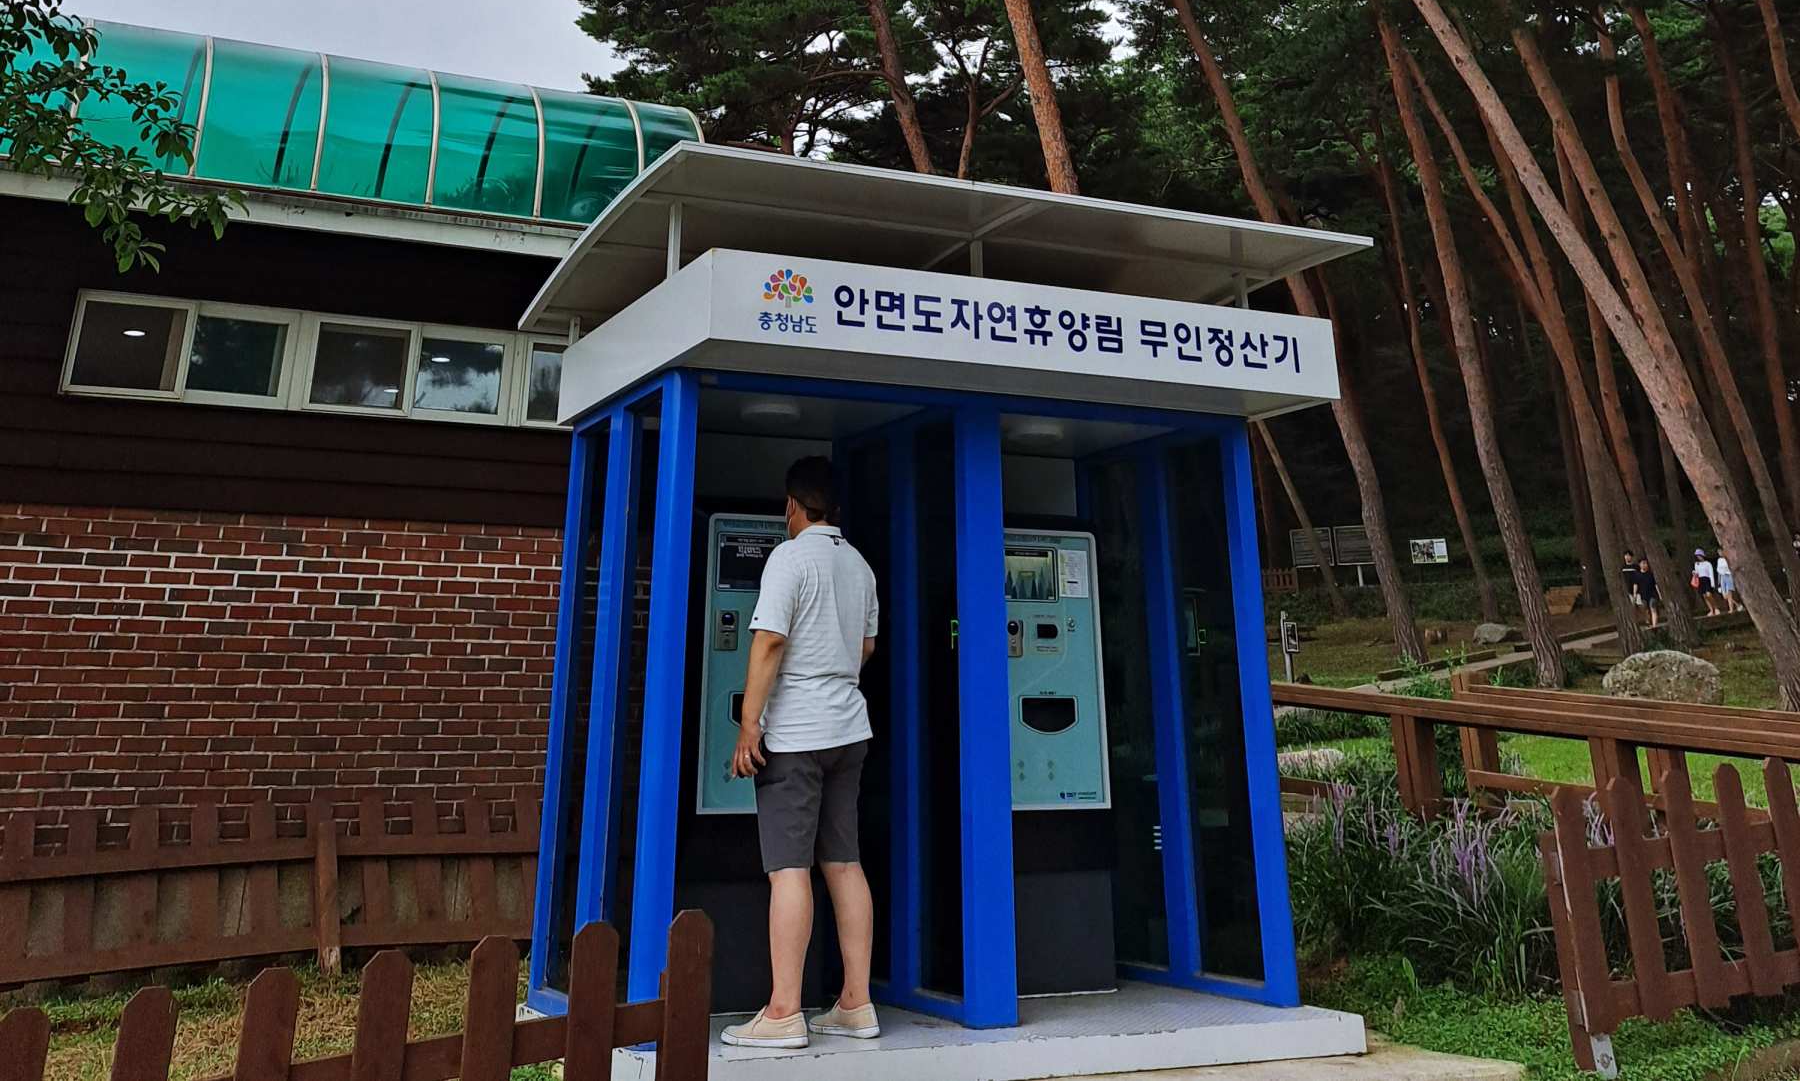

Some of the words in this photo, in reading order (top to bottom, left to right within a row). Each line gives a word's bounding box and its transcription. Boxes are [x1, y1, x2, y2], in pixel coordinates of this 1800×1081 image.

[758, 311, 818, 334] 충청남도
[834, 285, 1124, 353] 안면도자연휴양림
[1139, 320, 1301, 373] 무인정산기
